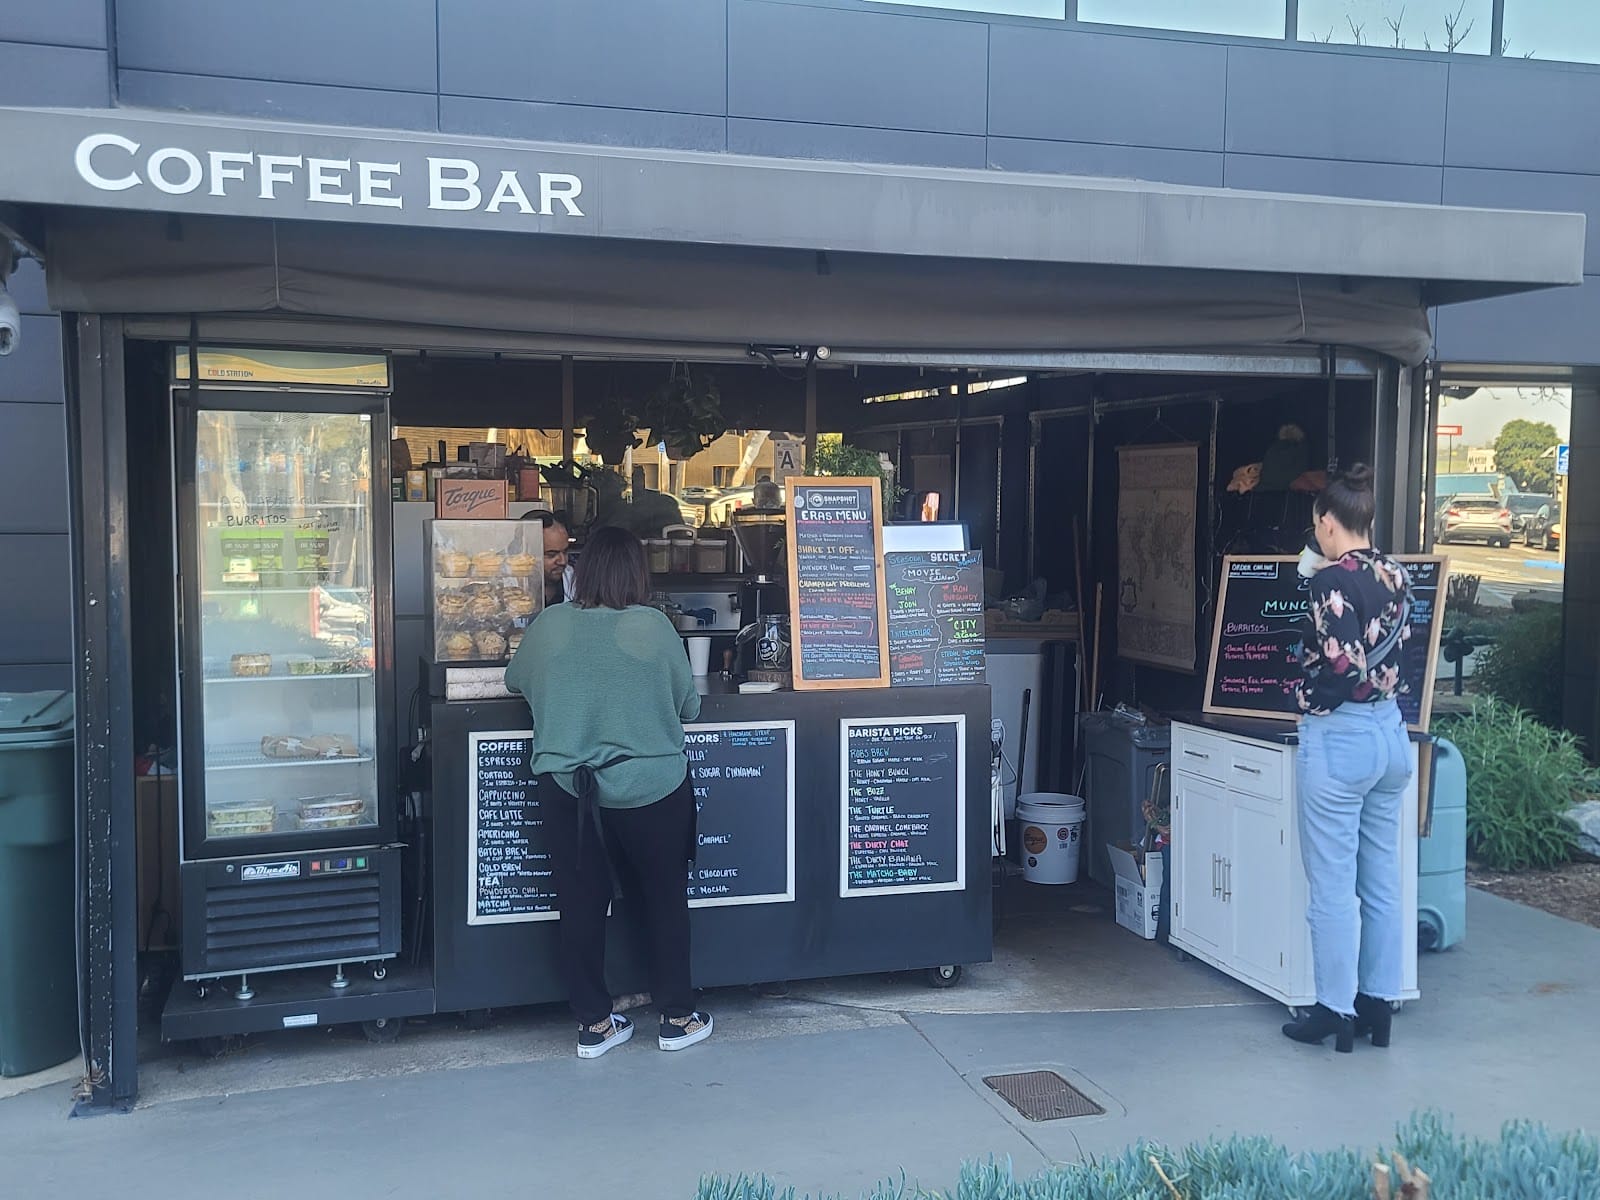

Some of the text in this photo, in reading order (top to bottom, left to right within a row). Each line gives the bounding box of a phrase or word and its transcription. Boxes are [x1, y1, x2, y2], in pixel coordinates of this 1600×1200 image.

[74, 132, 585, 217] COFFEE BAR
[208, 369, 254, 377] COLD STATION
[780, 450, 795, 469] A
[444, 486, 501, 512] Torque
[227, 514, 287, 527] BURRITOS
[801, 510, 866, 521] ERAS MENU
[908, 568, 941, 577] MOVIE
[1264, 600, 1308, 613] MUNC
[954, 619, 976, 630] CITY
[849, 727, 923, 738] BARISTA PICKS
[479, 741, 523, 751] COFFEE
[850, 747, 890, 758] ROBS BREW
[479, 757, 521, 766] ESPRESSO
[479, 770, 513, 780] CORTADO
[699, 767, 720, 778] SUGAR
[849, 768, 909, 778] THE HONEY BUNCH
[479, 789, 525, 801] CAPPUCCINO
[849, 788, 862, 796] THE
[479, 809, 523, 820] CAFE LATTE
[849, 806, 894, 815] THE TURTLE
[478, 829, 520, 839] AMERICANO
[849, 825, 861, 834] THE
[865, 824, 892, 832] CARAMEL
[850, 840, 908, 850] THE DIRTY CHAI
[478, 847, 528, 858] BATCH BREW
[849, 857, 861, 865] THE
[866, 856, 886, 864] DIRTY
[479, 863, 522, 873] COLD BREW
[699, 869, 738, 880] CHOCOLATE
[849, 872, 862, 880] THE
[479, 877, 500, 886] TEA
[480, 888, 518, 896] POWDERED
[478, 900, 510, 909] MATCHA
